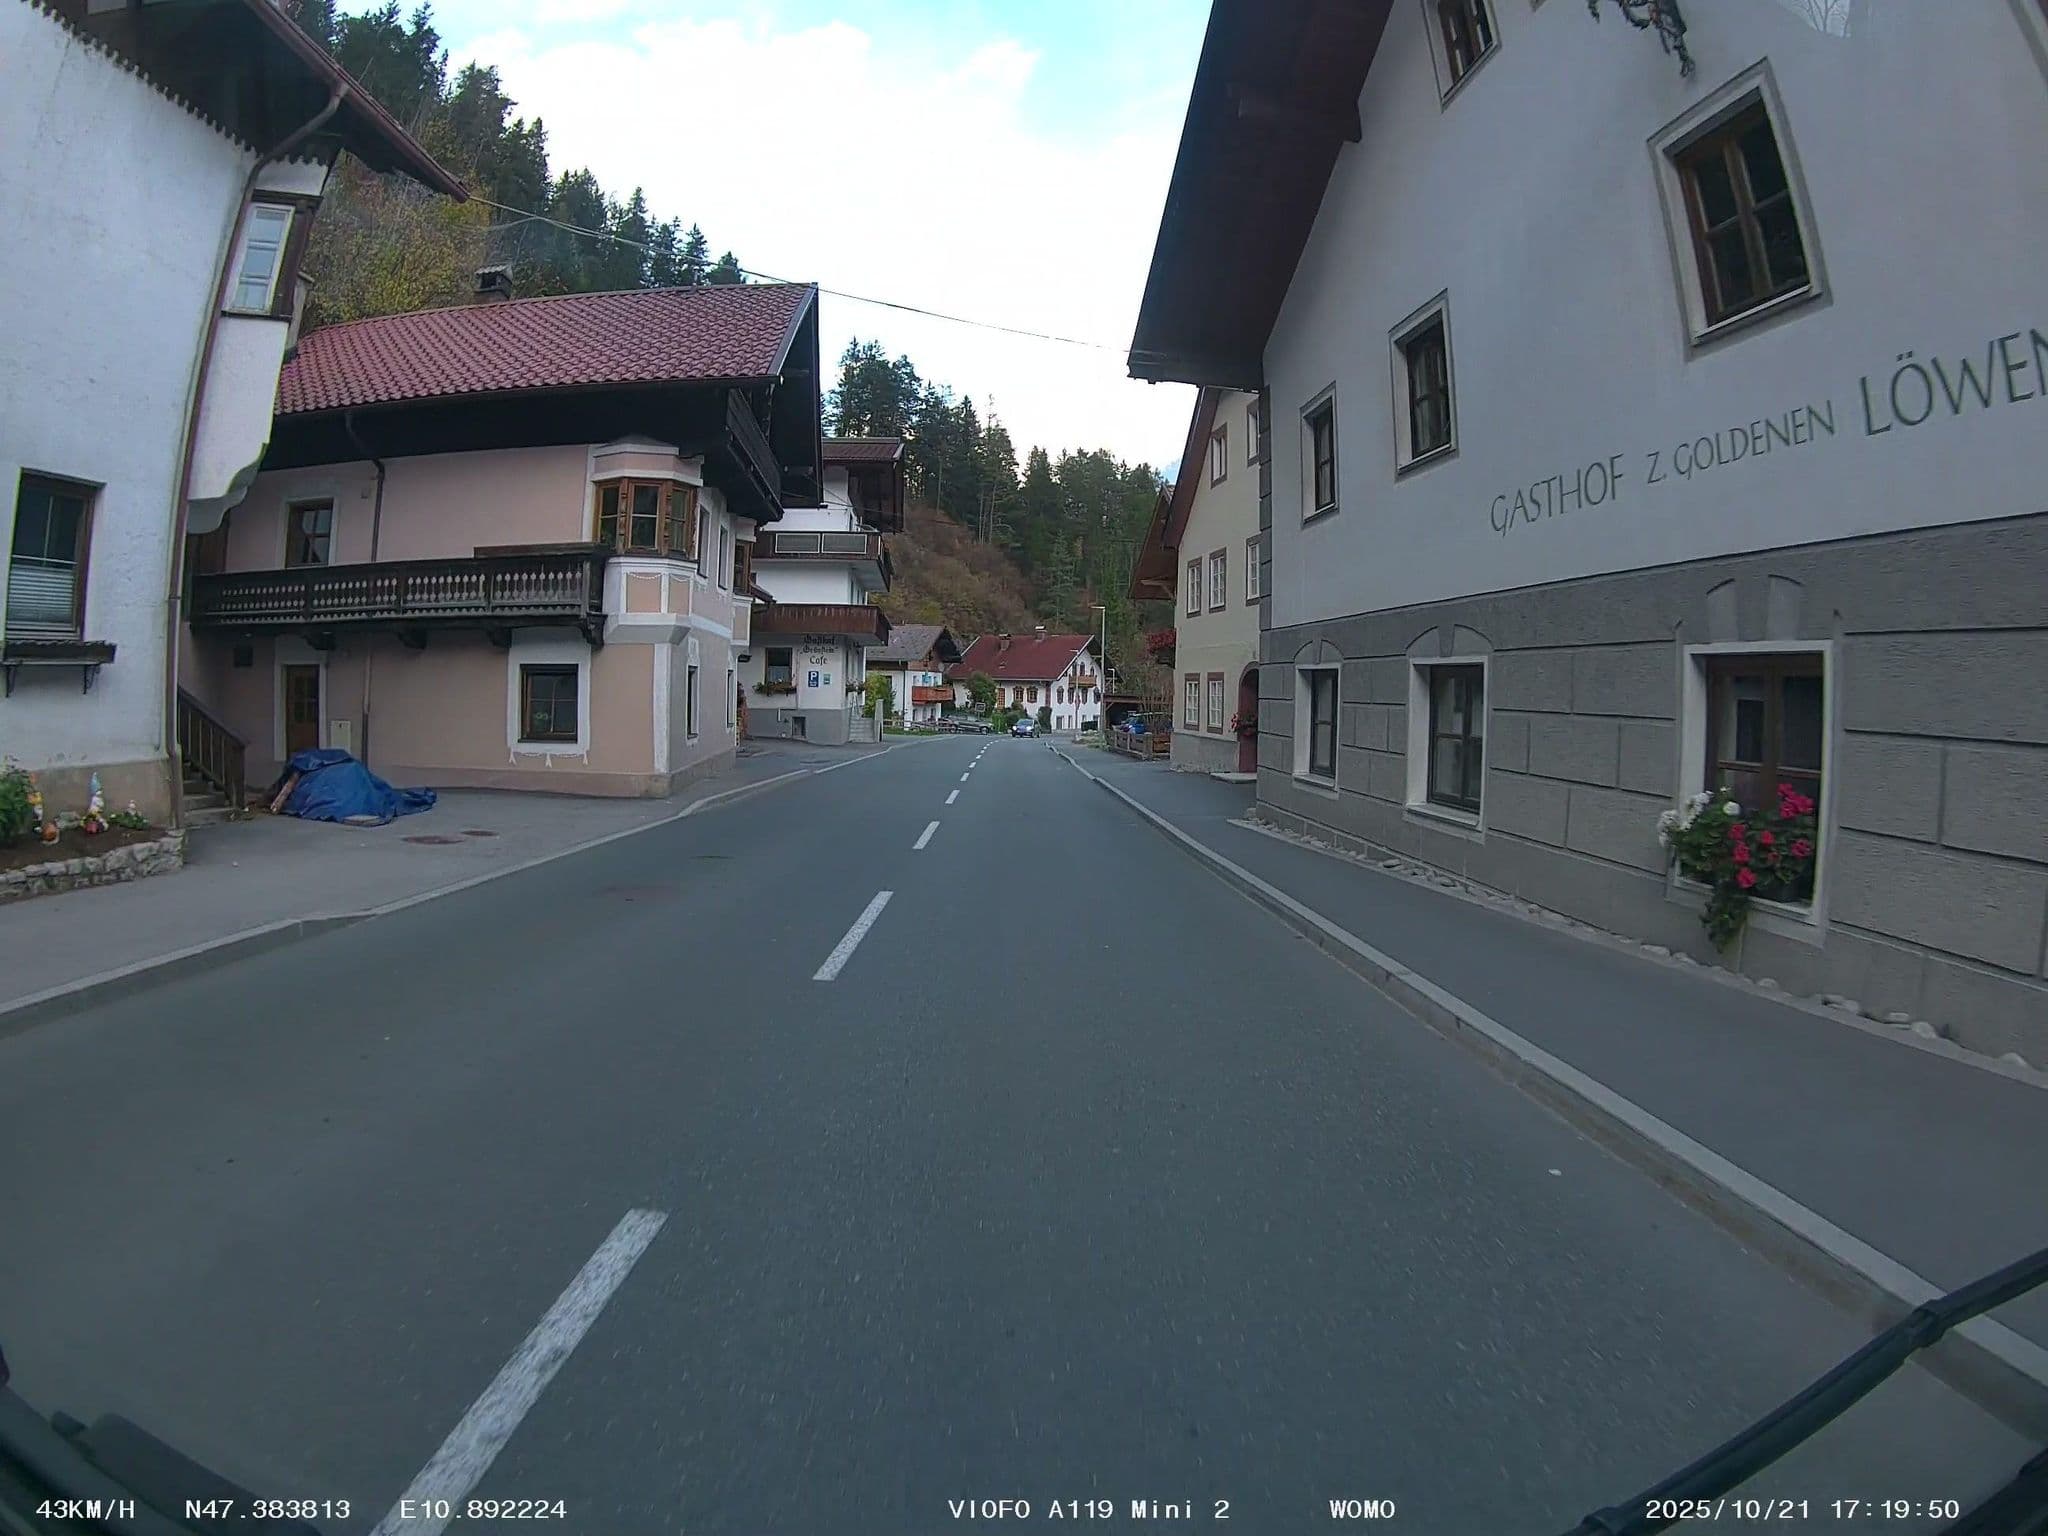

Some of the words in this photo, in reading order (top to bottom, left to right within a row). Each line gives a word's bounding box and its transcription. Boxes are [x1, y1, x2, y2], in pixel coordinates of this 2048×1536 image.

[1490, 453, 1625, 538] GASTHOF
[1647, 451, 1667, 484] Z.
[1673, 399, 1836, 480] GOLDENEN
[810, 671, 818, 681] P
